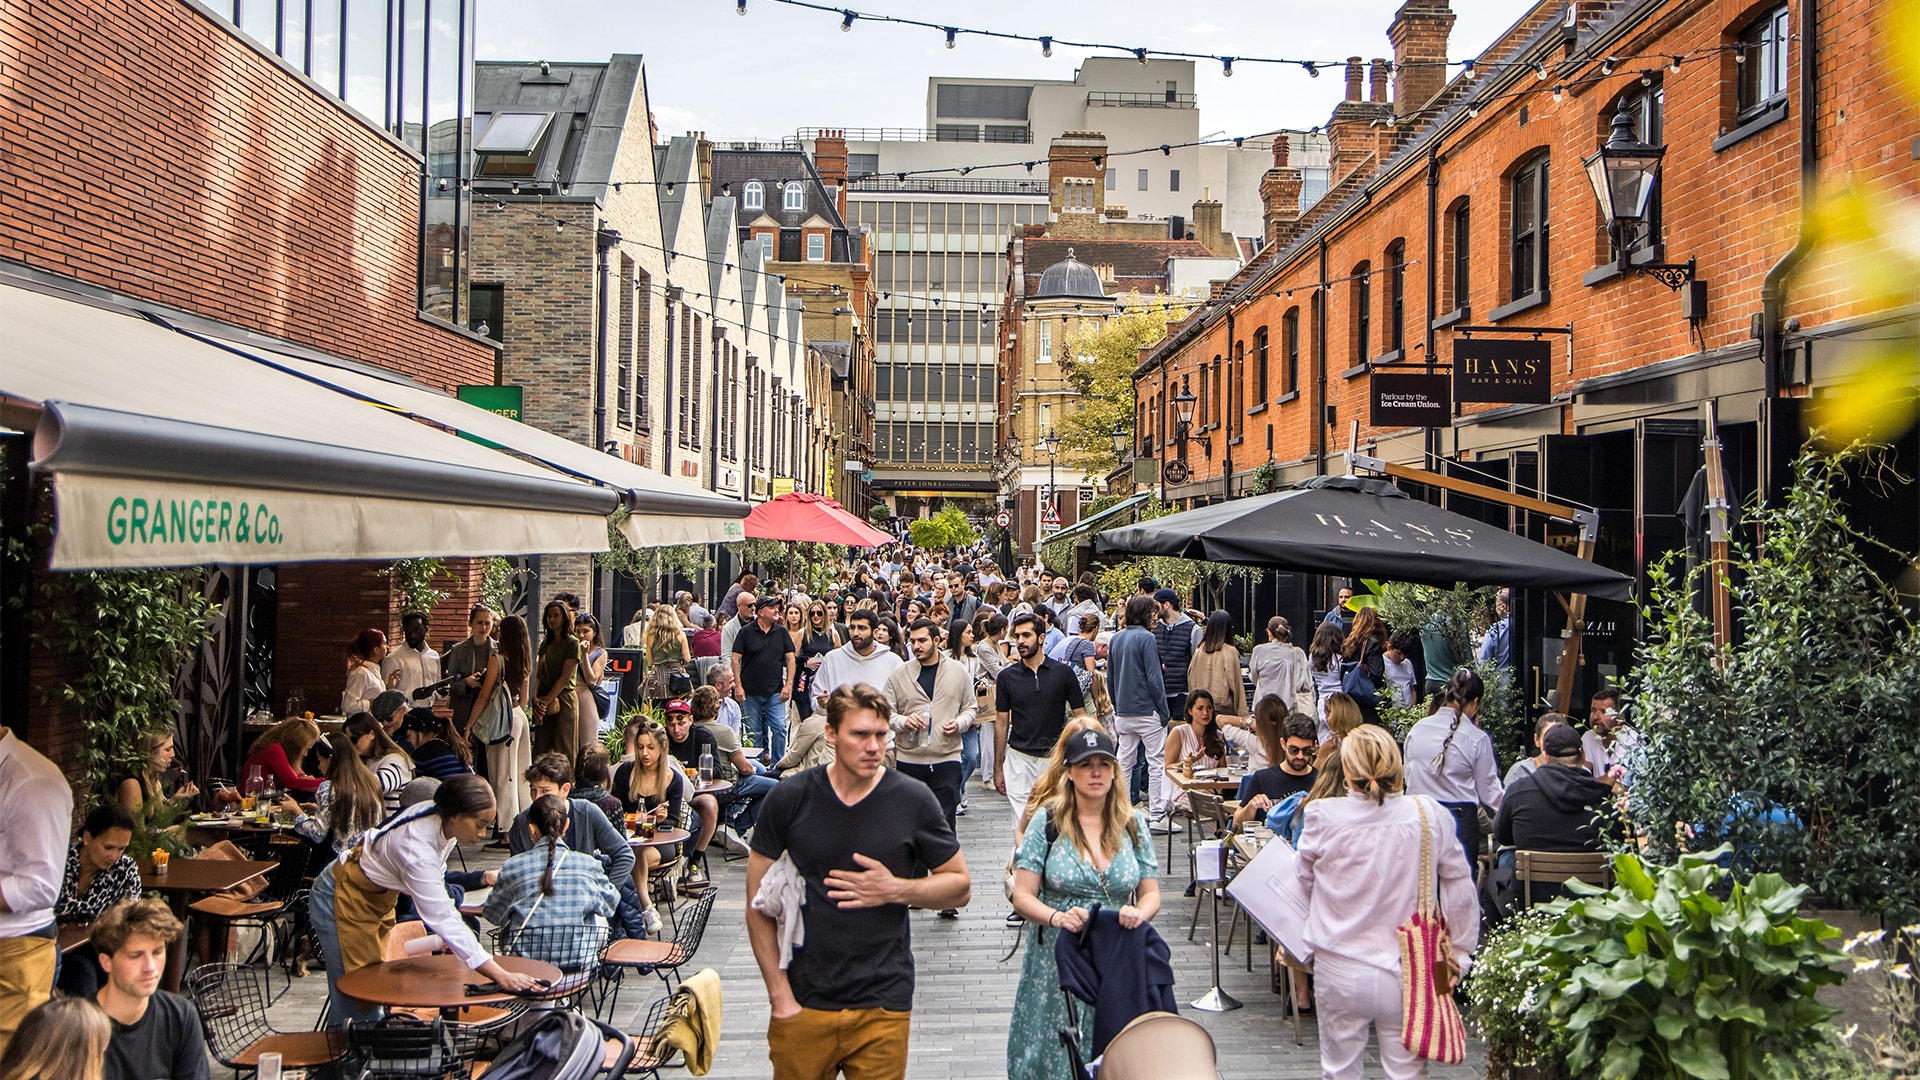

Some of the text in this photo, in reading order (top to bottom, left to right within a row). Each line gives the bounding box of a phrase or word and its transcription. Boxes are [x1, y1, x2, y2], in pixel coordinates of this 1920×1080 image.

[1380, 393, 1405, 401] Parlour
[1405, 393, 1415, 402] by
[1340, 529, 1378, 538] BAR
[1416, 537, 1475, 548] GRILL
